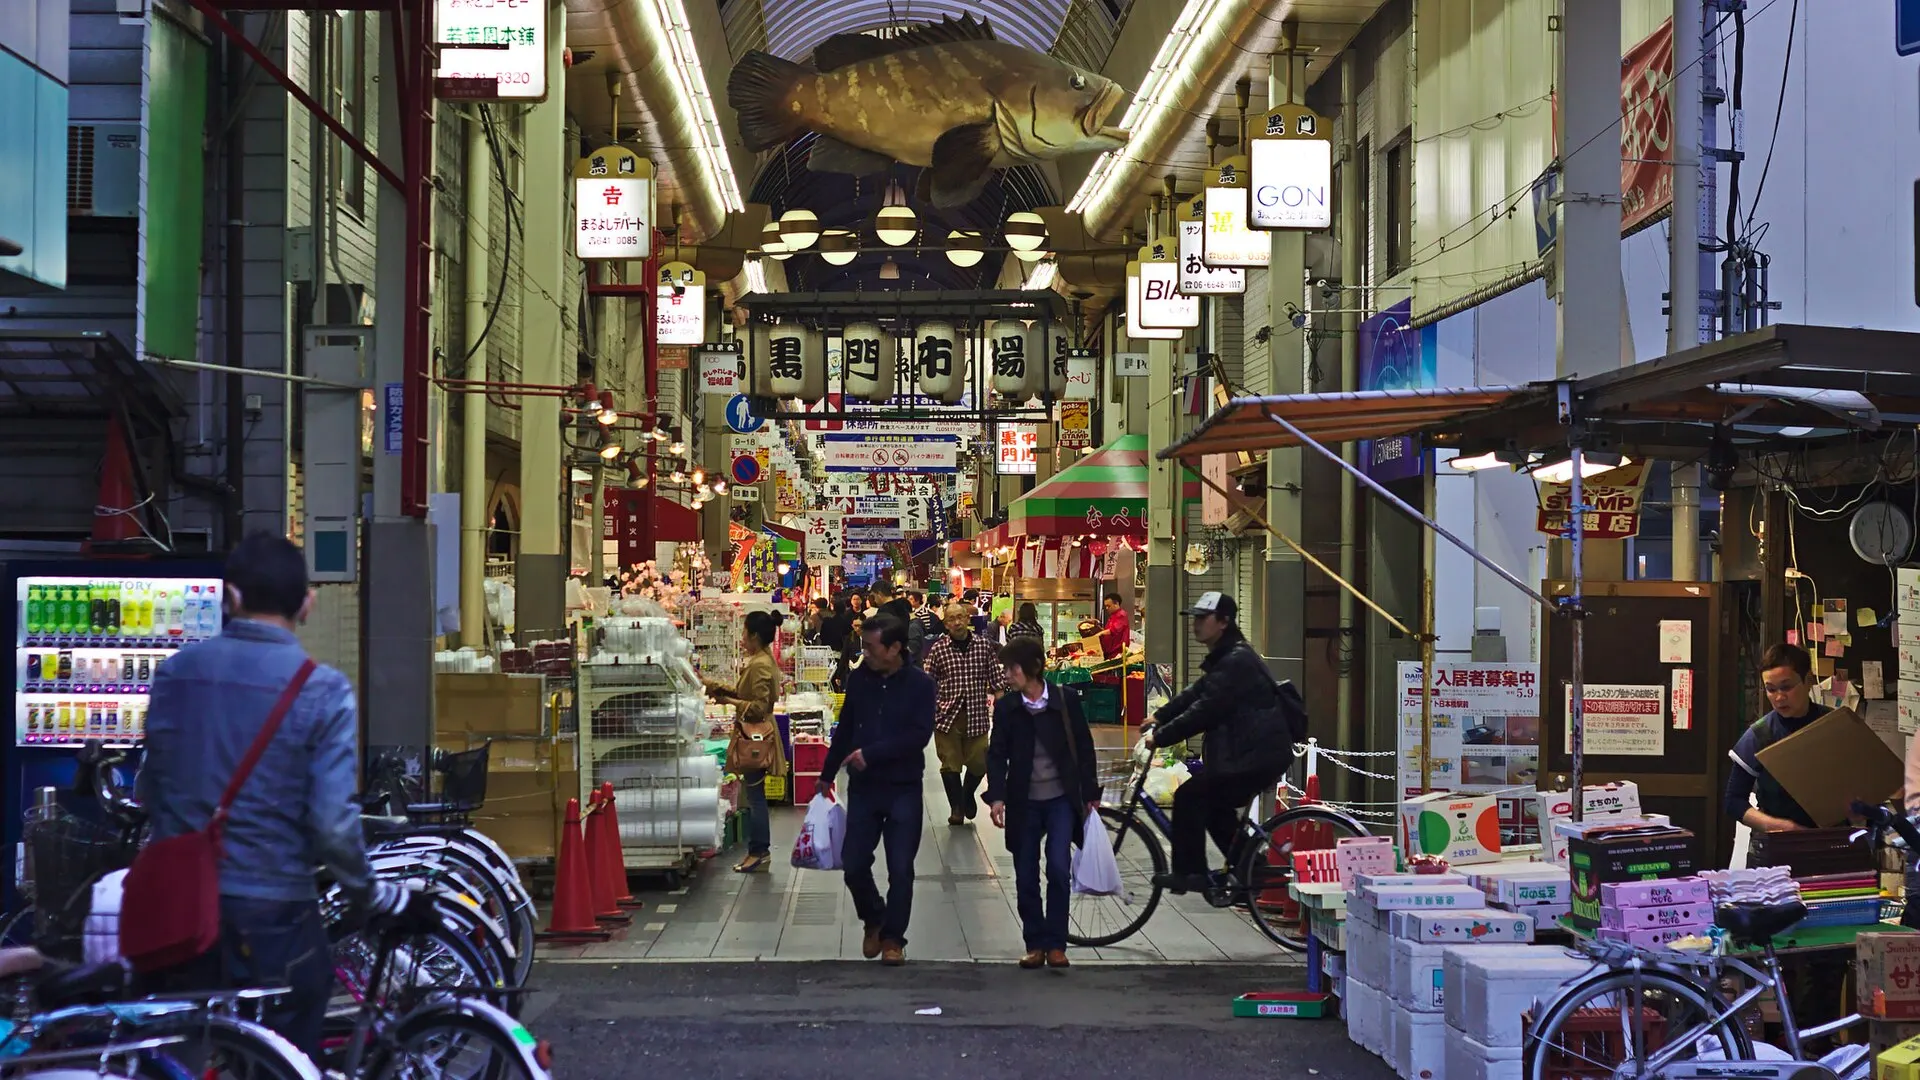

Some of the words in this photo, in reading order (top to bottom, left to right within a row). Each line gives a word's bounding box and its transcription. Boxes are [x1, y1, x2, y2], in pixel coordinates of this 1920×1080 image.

[1266, 114, 1317, 136] 黒門
[589, 155, 635, 175] 黒門
[1257, 185, 1324, 207] GON
[808, 517, 827, 535] 活
[88, 579, 152, 590] SUNTORY
[1435, 669, 1536, 688] 入居者募集中
